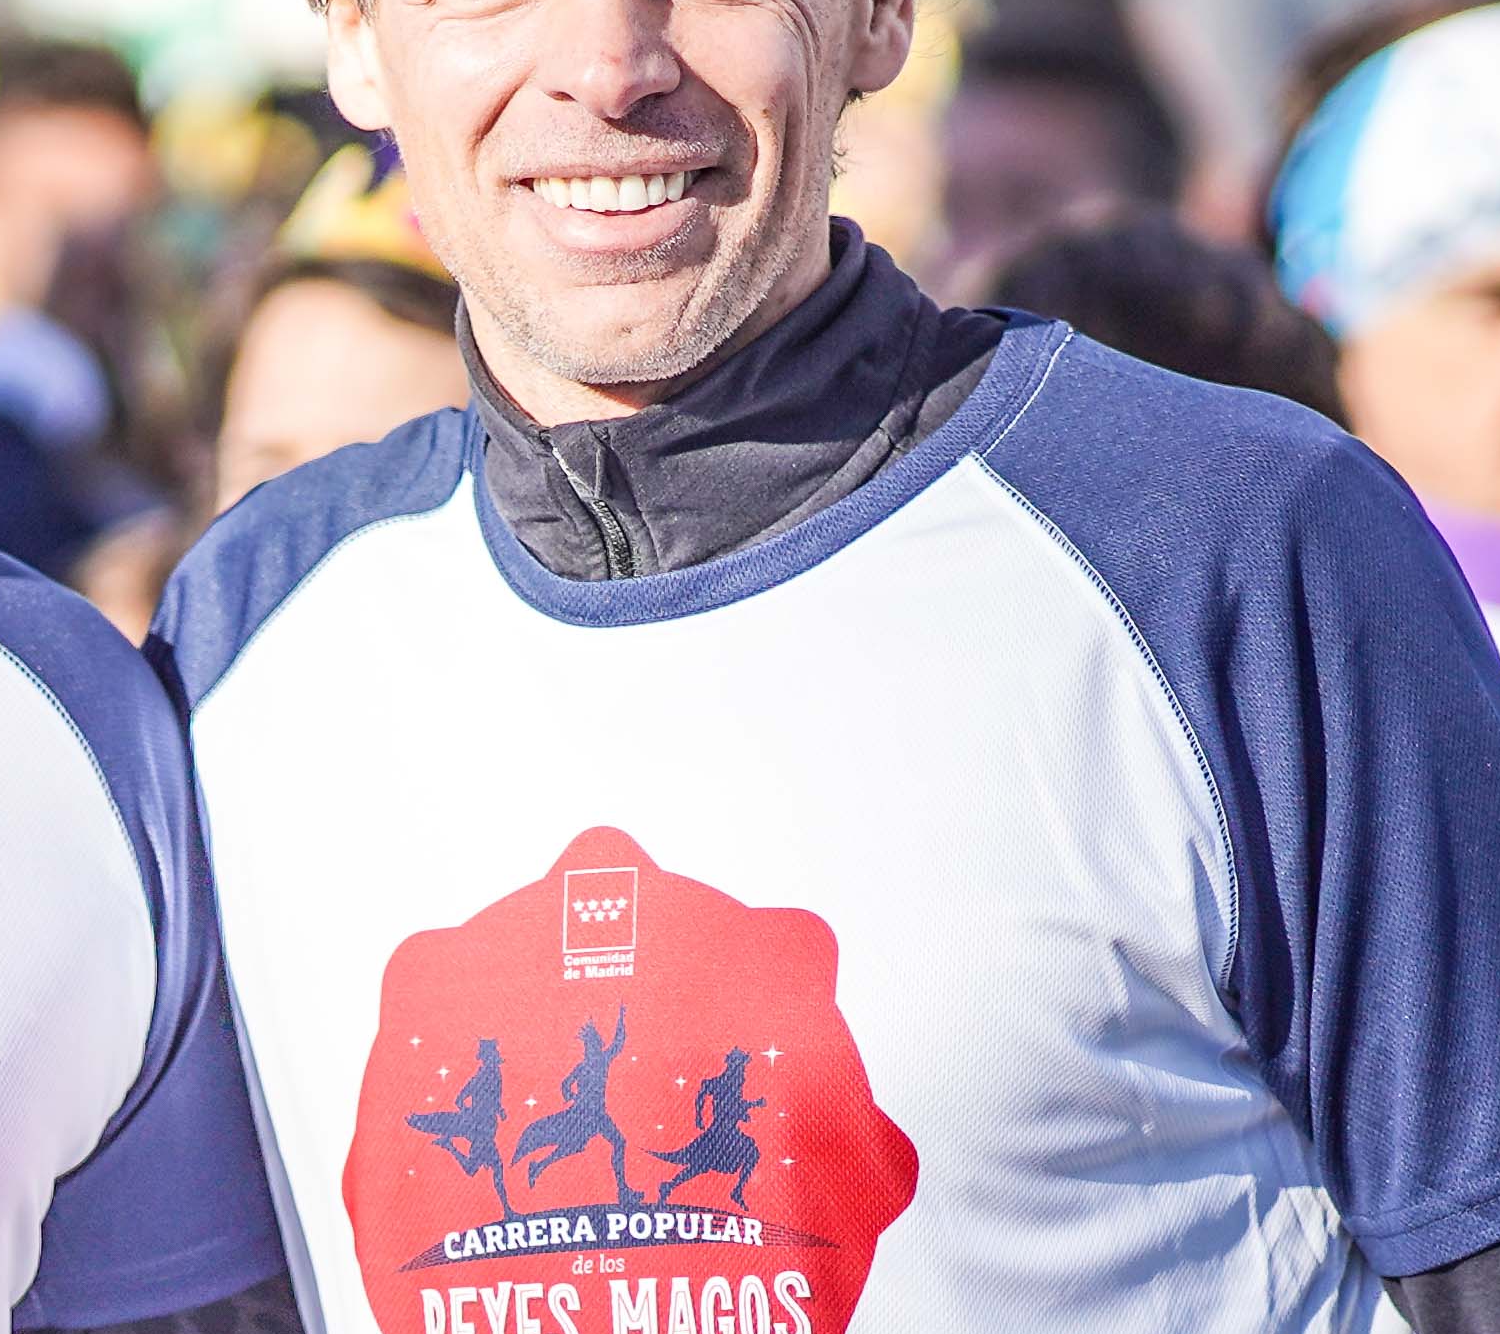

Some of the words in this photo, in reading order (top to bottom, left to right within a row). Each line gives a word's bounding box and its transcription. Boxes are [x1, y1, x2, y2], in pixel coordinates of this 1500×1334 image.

[563, 951, 634, 966] Comunidad
[563, 968, 580, 980] de
[585, 964, 634, 978] Madrid
[444, 1216, 596, 1261] CARRERA
[606, 1213, 764, 1247] POPULAR
[571, 1256, 594, 1275] de
[599, 1254, 625, 1273] los
